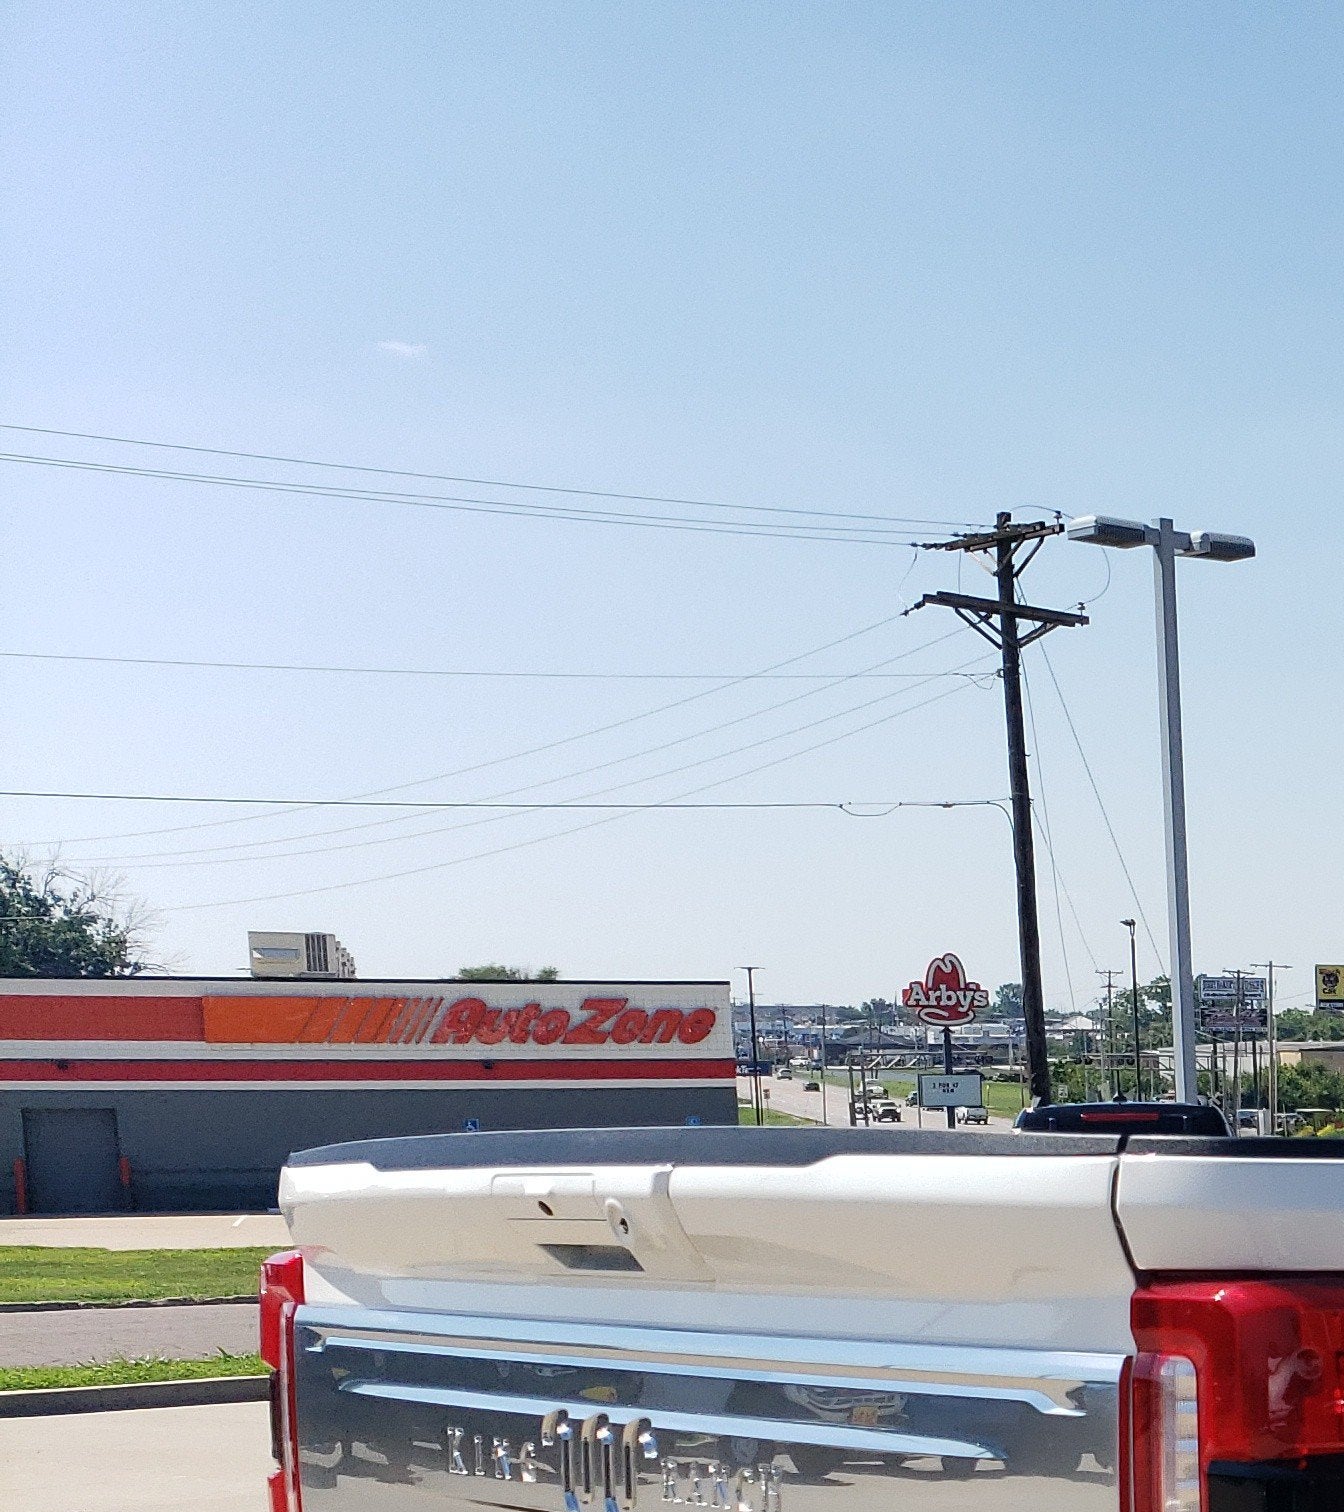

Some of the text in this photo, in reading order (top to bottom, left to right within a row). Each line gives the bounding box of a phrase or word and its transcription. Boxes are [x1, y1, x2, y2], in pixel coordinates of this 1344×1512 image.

[429, 997, 717, 1046] AutoZone
[908, 983, 989, 1013] Arby's
[446, 1426, 538, 1483] KING
